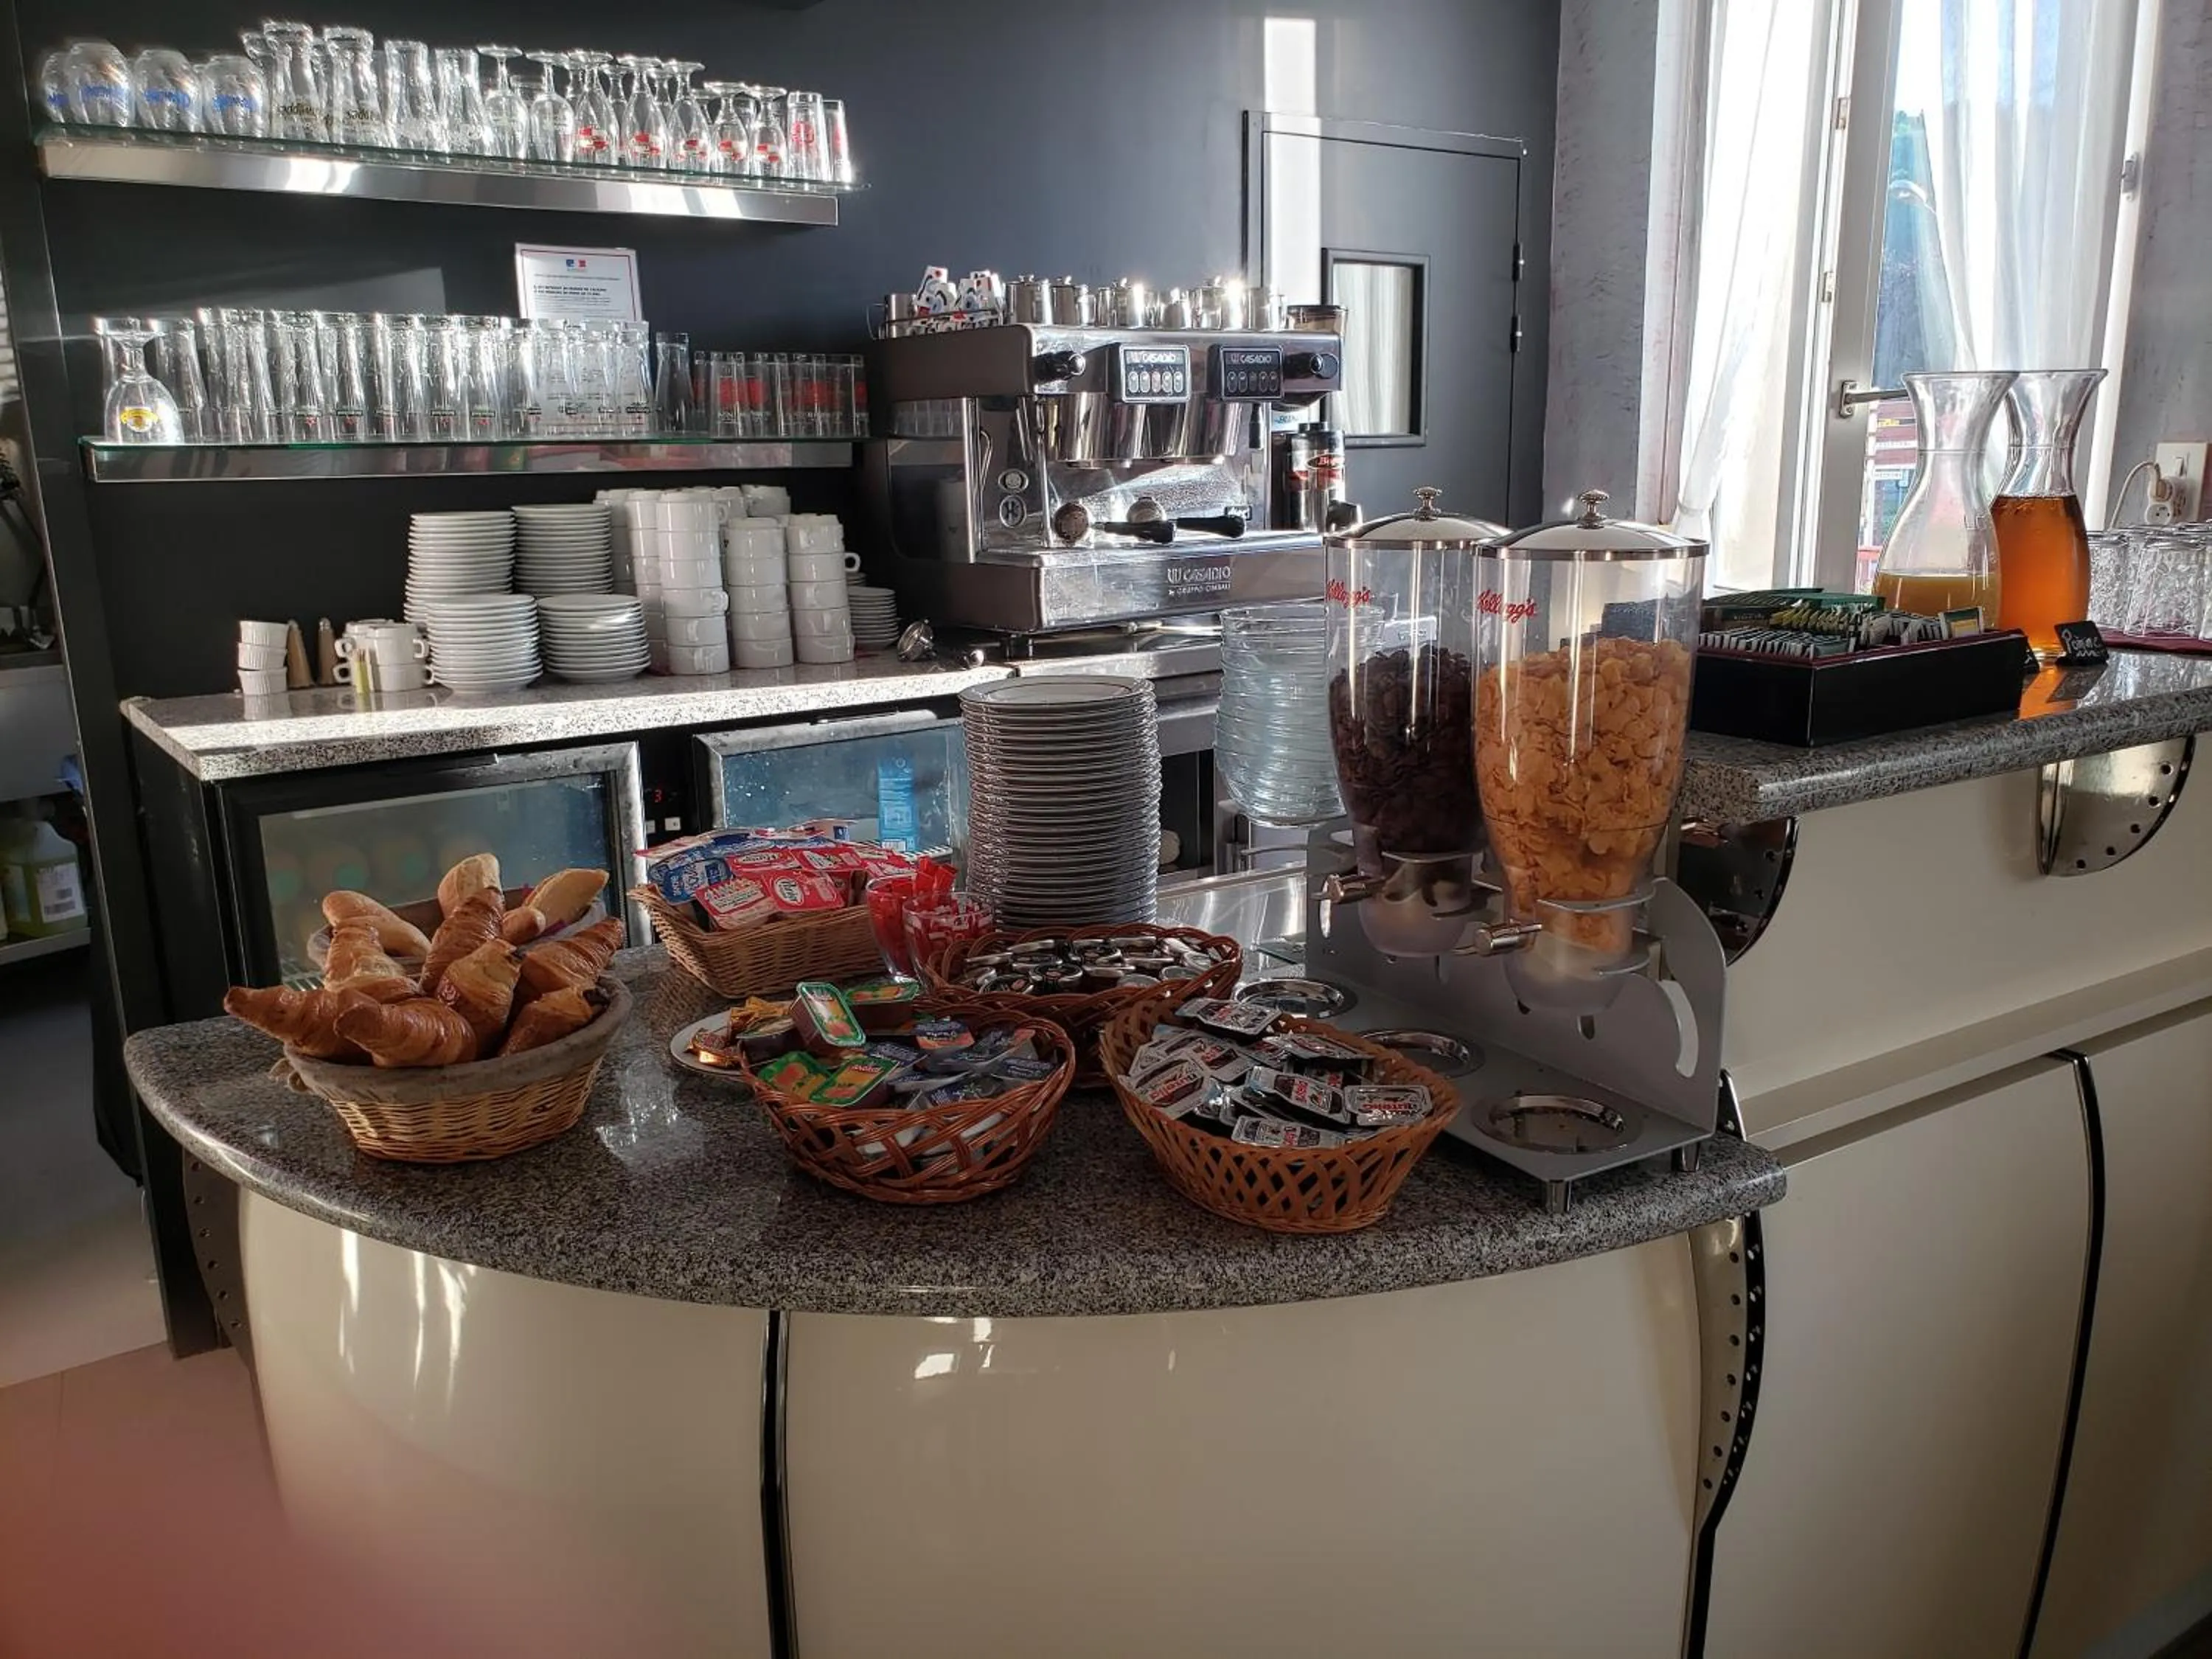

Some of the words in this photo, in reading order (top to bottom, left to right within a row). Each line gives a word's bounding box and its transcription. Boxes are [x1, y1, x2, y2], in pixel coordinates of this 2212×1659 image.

[1241, 355, 1272, 364] CASADIO
[1183, 566, 1231, 582] CASADIO
[1477, 589, 1537, 623] Kellgg's
